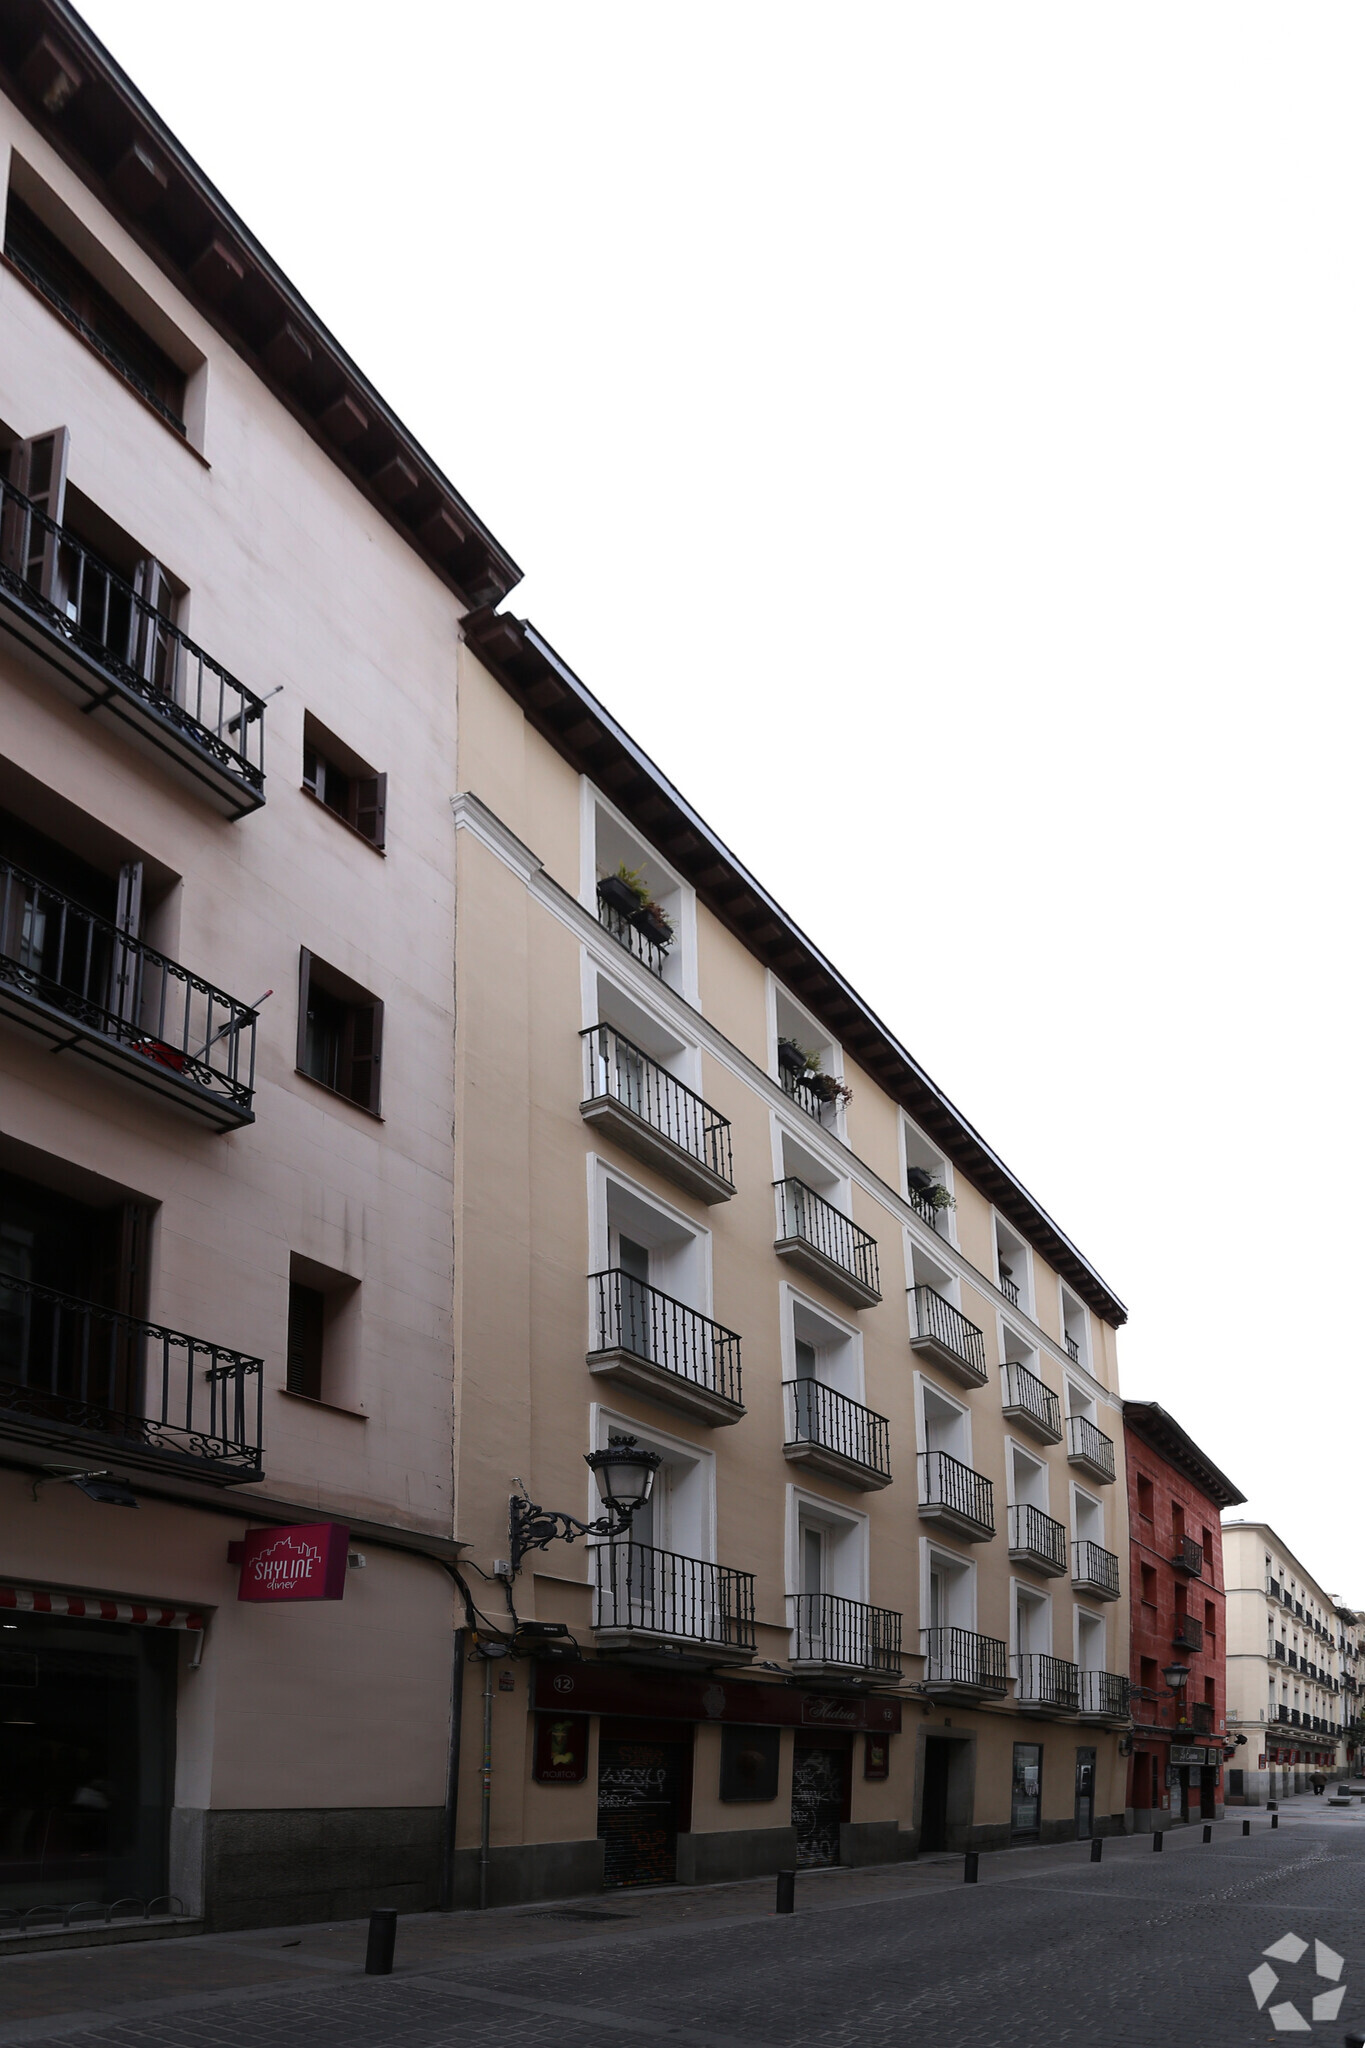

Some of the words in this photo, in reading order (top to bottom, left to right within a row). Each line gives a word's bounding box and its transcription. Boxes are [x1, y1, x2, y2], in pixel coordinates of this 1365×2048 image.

[254, 1558, 314, 1581] SKYLINE
[266, 1578, 298, 1591] diner
[556, 1677, 572, 1690] 12
